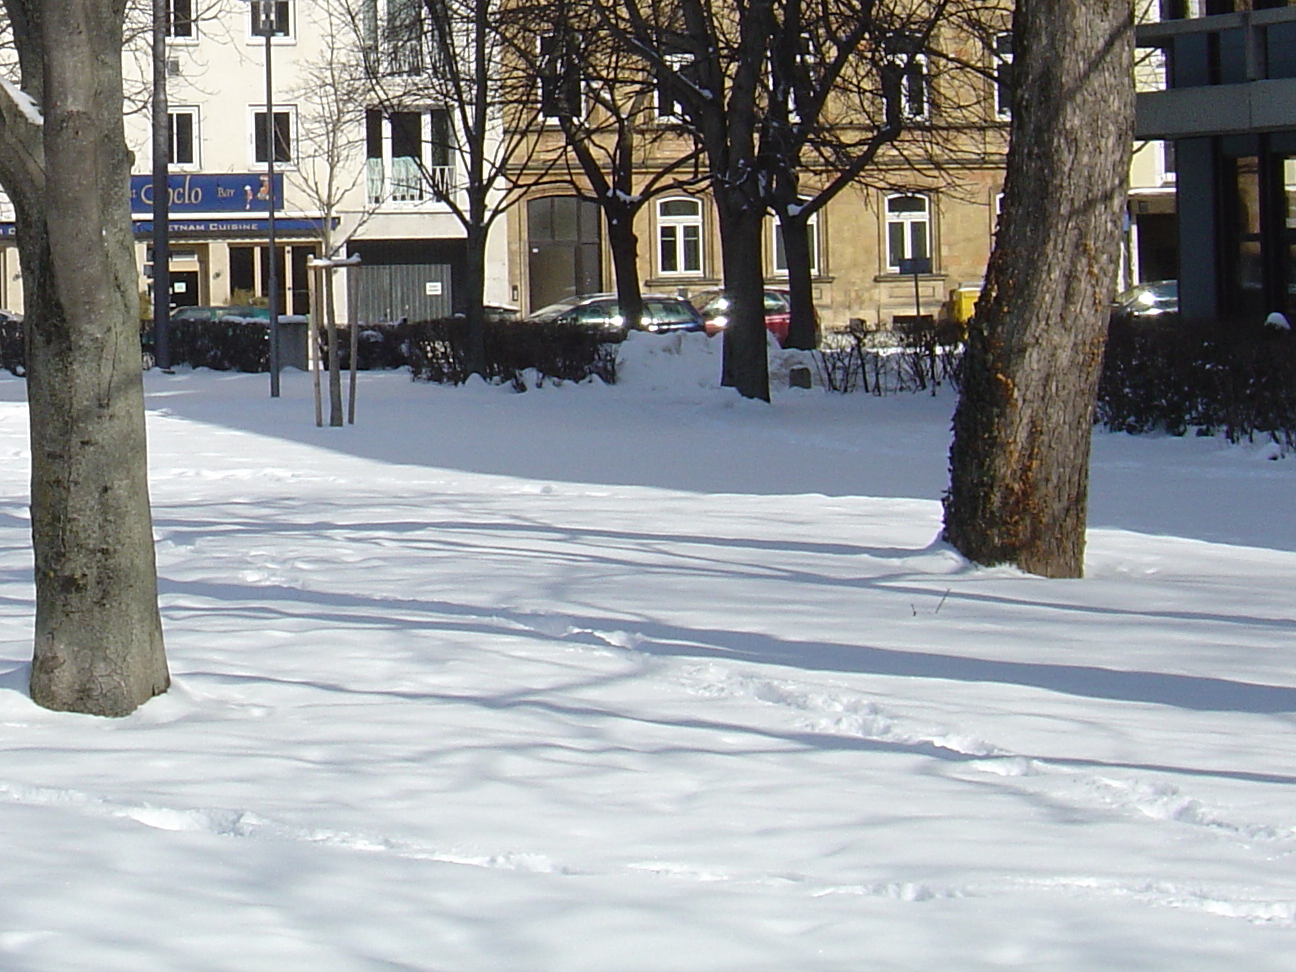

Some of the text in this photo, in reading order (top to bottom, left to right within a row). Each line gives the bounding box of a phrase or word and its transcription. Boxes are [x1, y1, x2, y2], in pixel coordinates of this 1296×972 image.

[217, 187, 235, 198] Bar
[168, 223, 258, 232] ETNAM CUISINE
